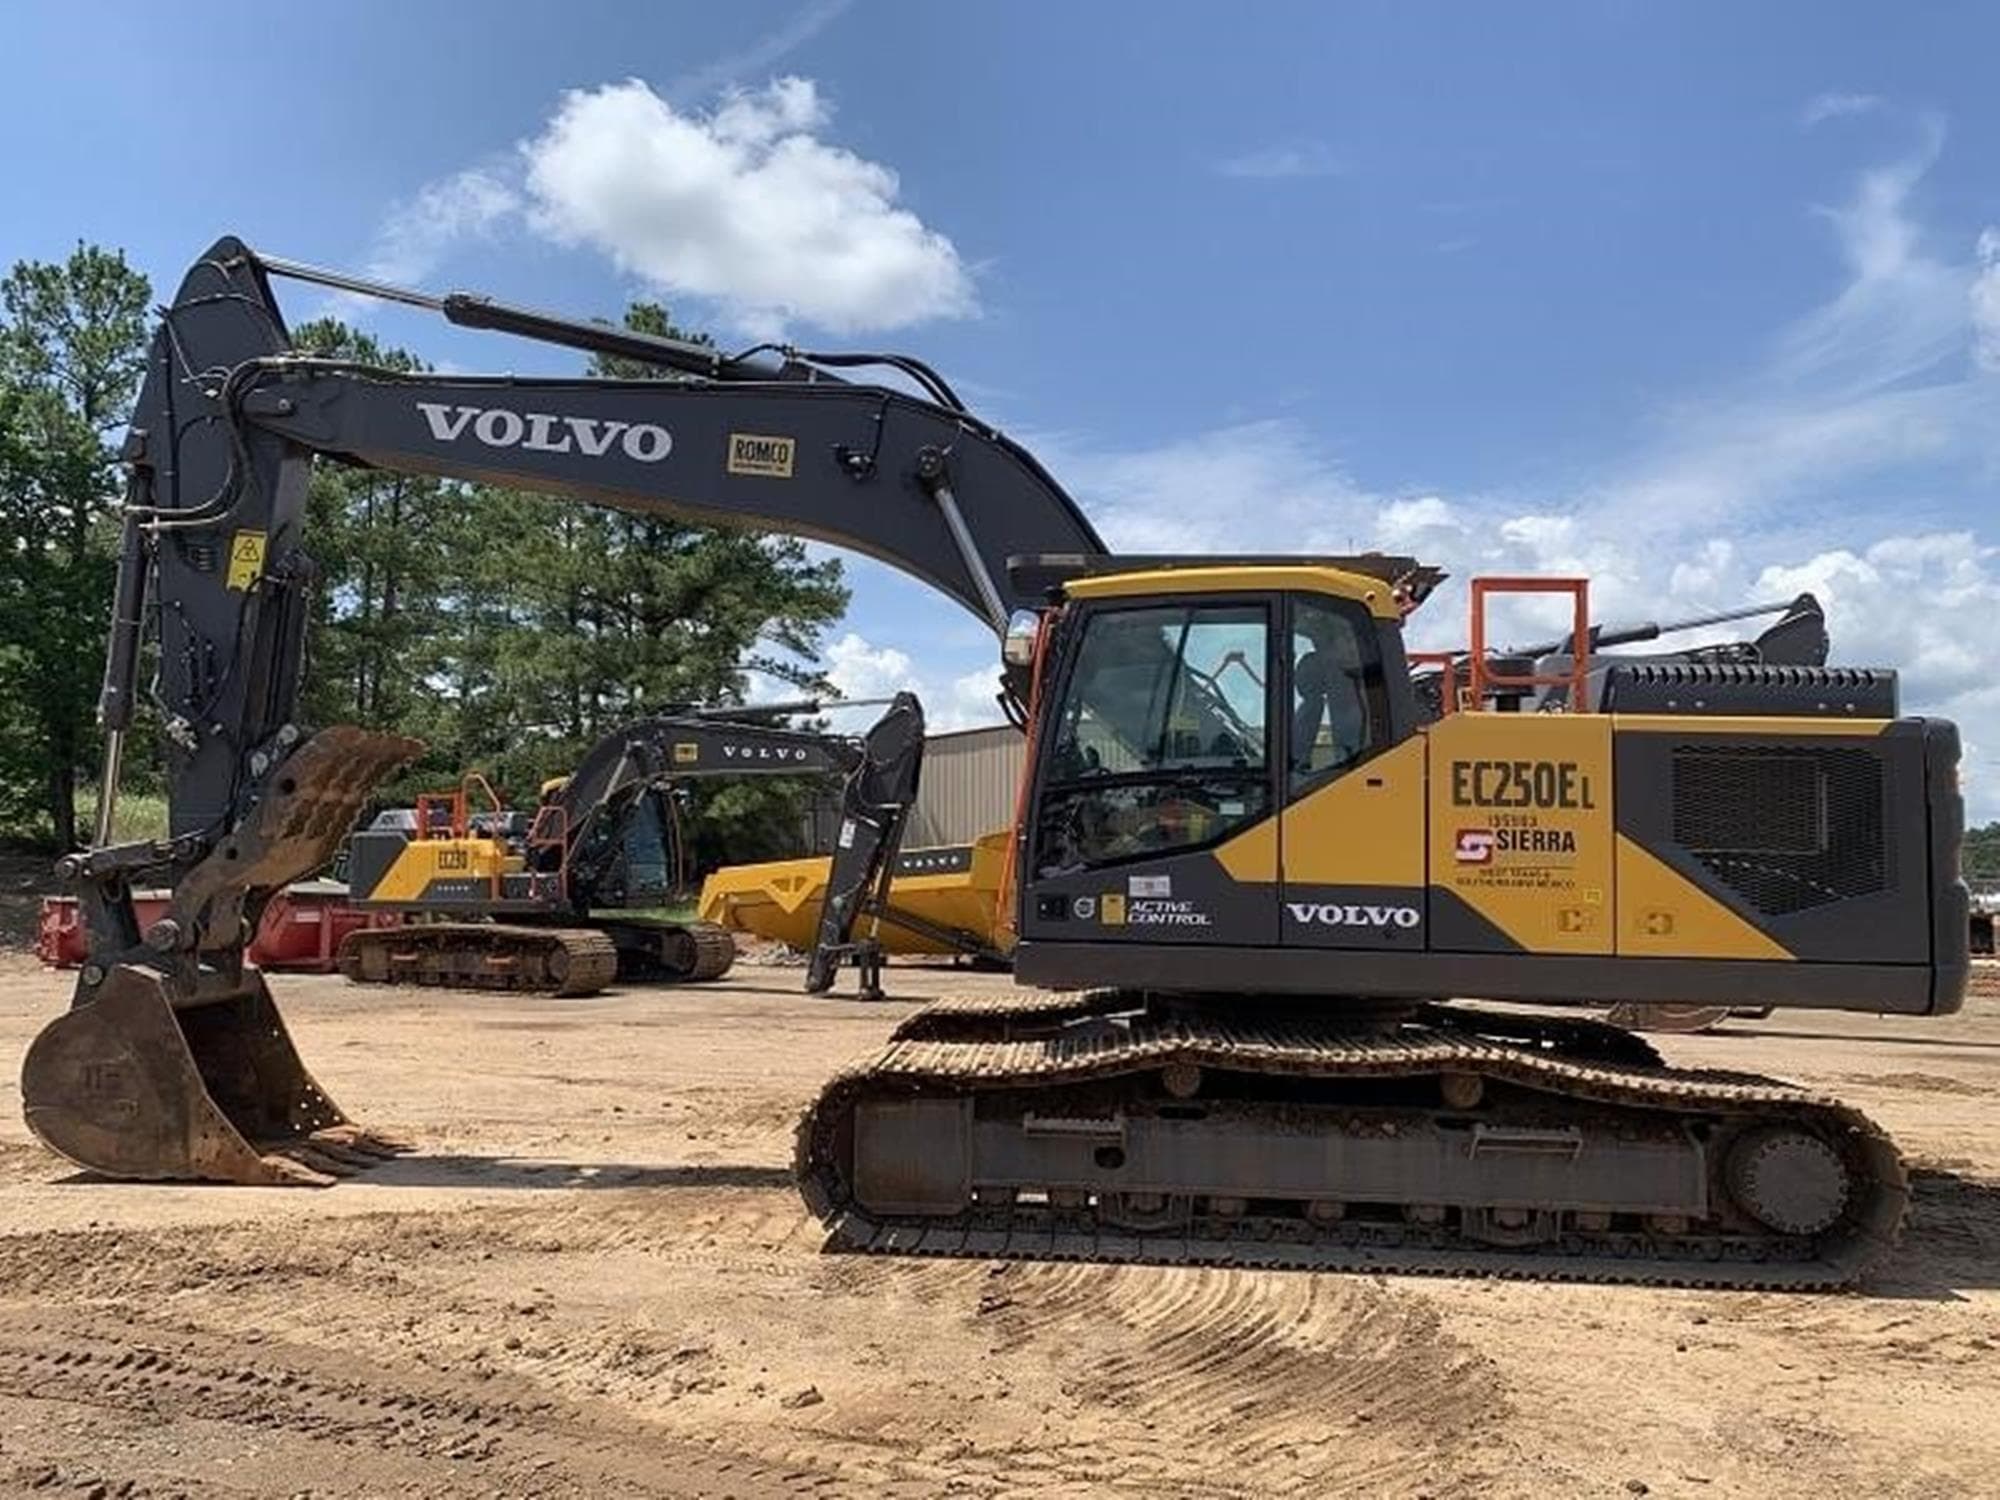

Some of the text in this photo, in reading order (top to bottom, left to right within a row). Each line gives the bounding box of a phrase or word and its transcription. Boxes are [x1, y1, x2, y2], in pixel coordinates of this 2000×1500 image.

[416, 402, 673, 462] VOLVO
[735, 439, 789, 464] ROMCO
[723, 745, 806, 760] VOLVO
[1496, 829, 1576, 852] SIERRA
[1130, 901, 1193, 913] ACTIVE
[1286, 902, 1420, 928] VOLVO
[1127, 913, 1212, 925] CONTROL
